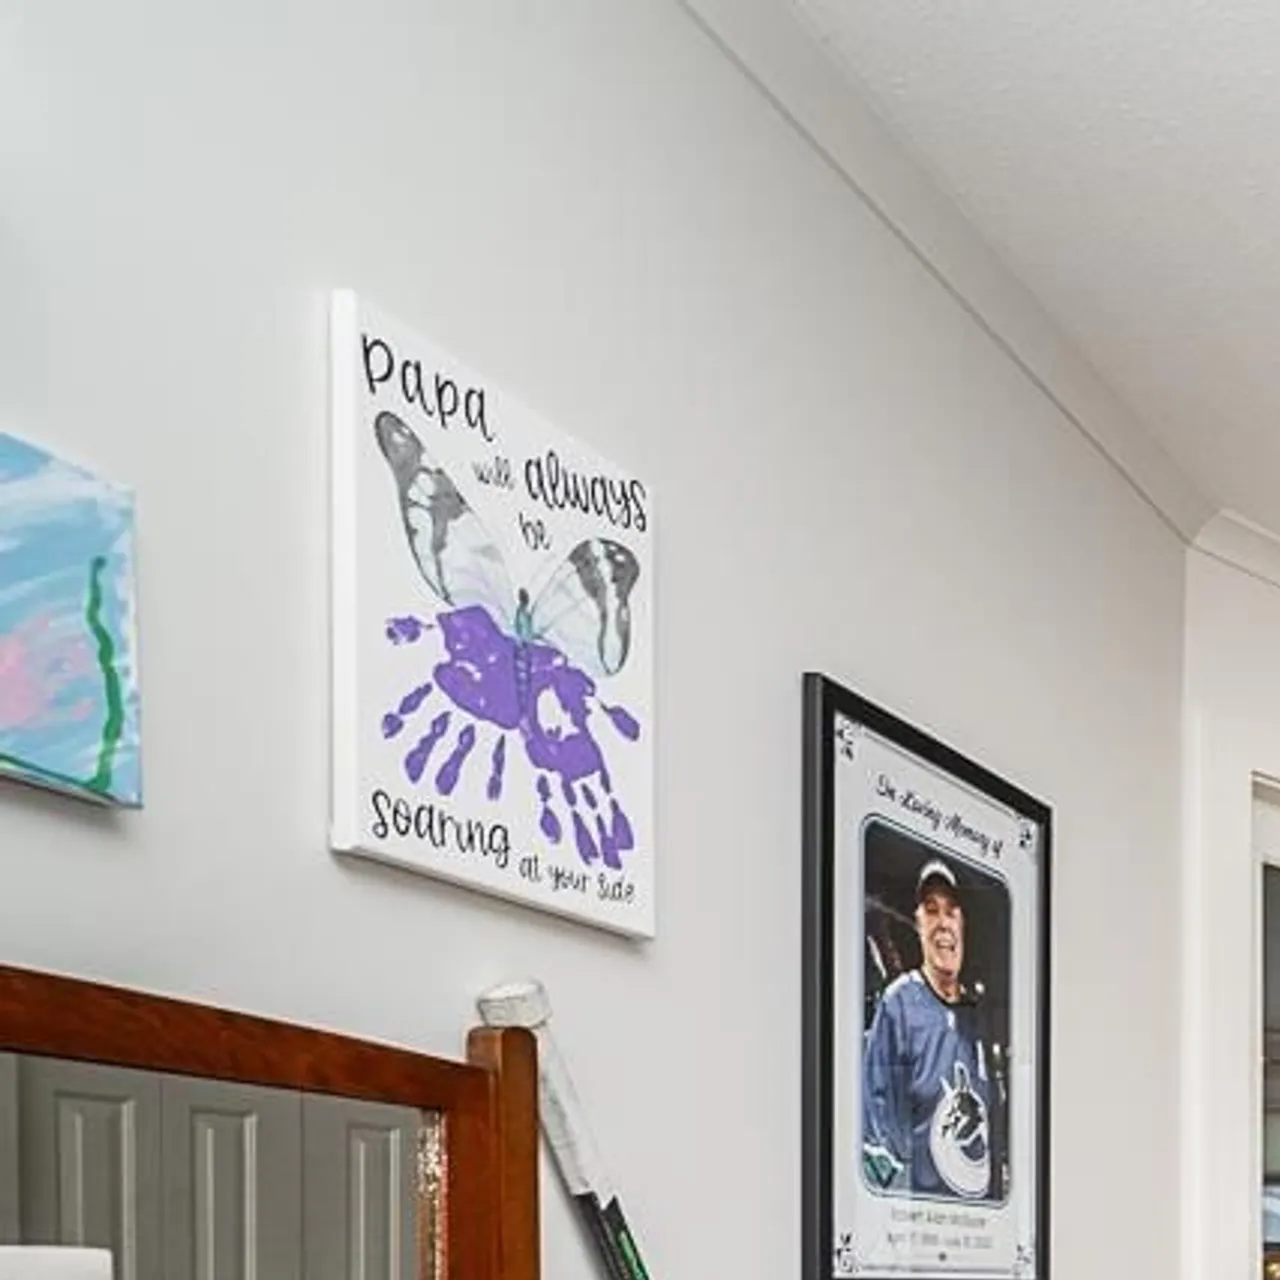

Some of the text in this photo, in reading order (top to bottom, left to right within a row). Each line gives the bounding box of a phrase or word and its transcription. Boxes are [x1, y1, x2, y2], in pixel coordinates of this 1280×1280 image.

[525, 449, 647, 533] always
[518, 511, 551, 550] be
[519, 853, 542, 883] at
[549, 864, 592, 894] your
